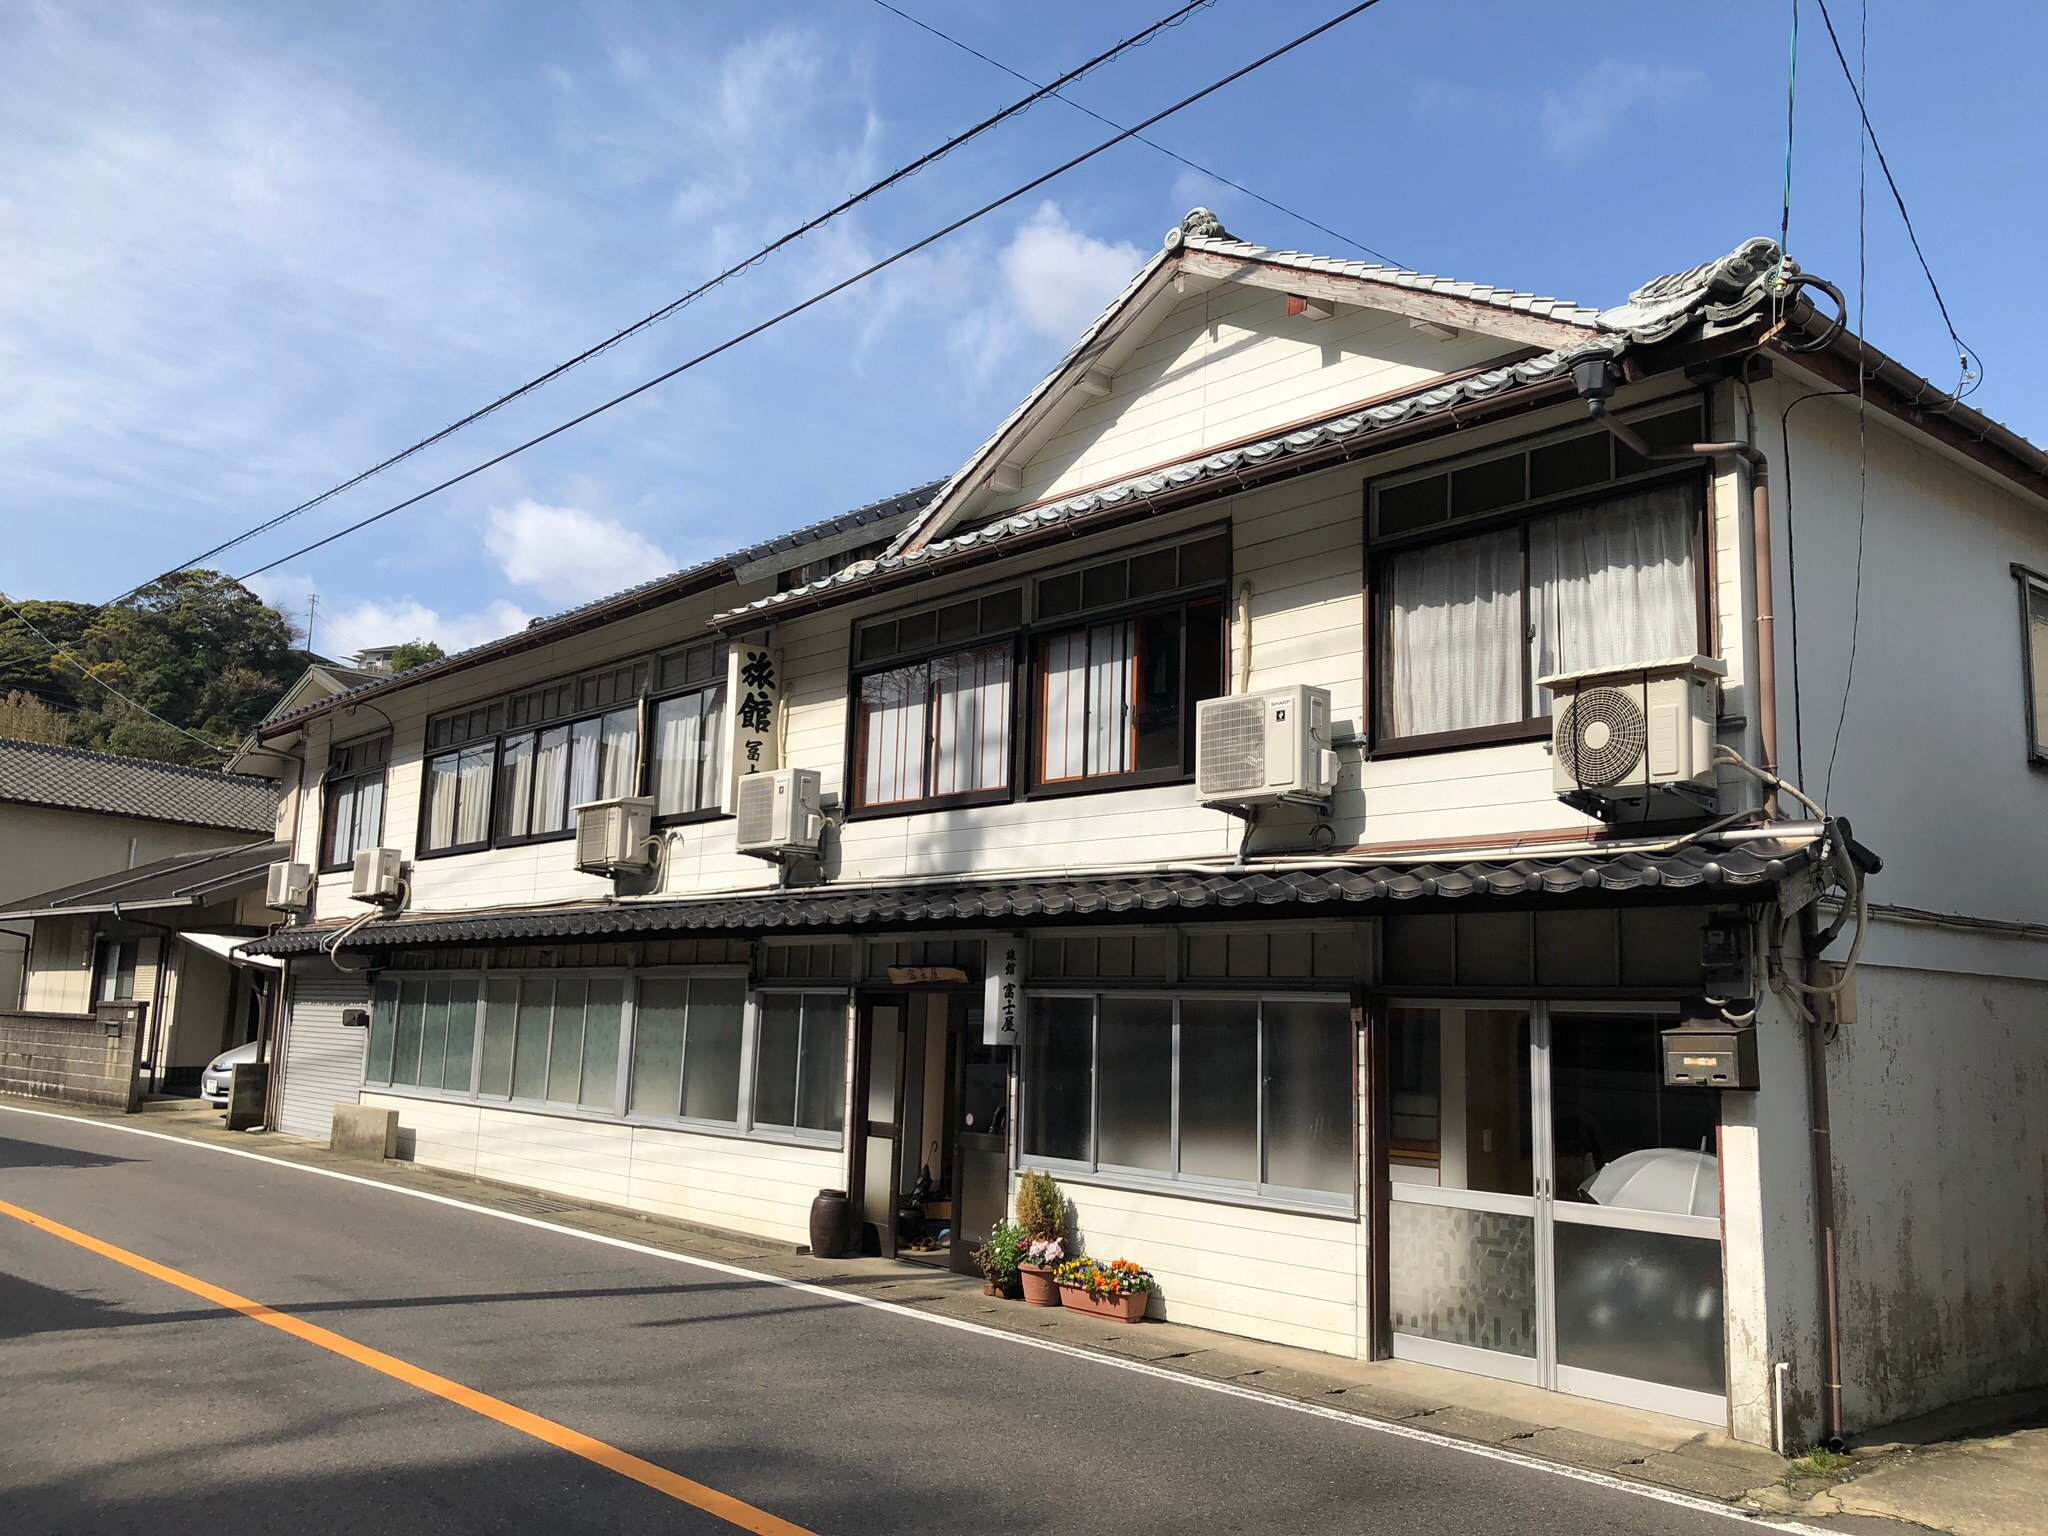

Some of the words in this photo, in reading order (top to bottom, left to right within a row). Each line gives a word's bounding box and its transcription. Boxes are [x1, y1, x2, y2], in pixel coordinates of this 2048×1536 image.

[737, 652, 776, 733] 旅館
[1005, 948, 1016, 976] 旅館
[1002, 983, 1016, 1032] 富士屋
